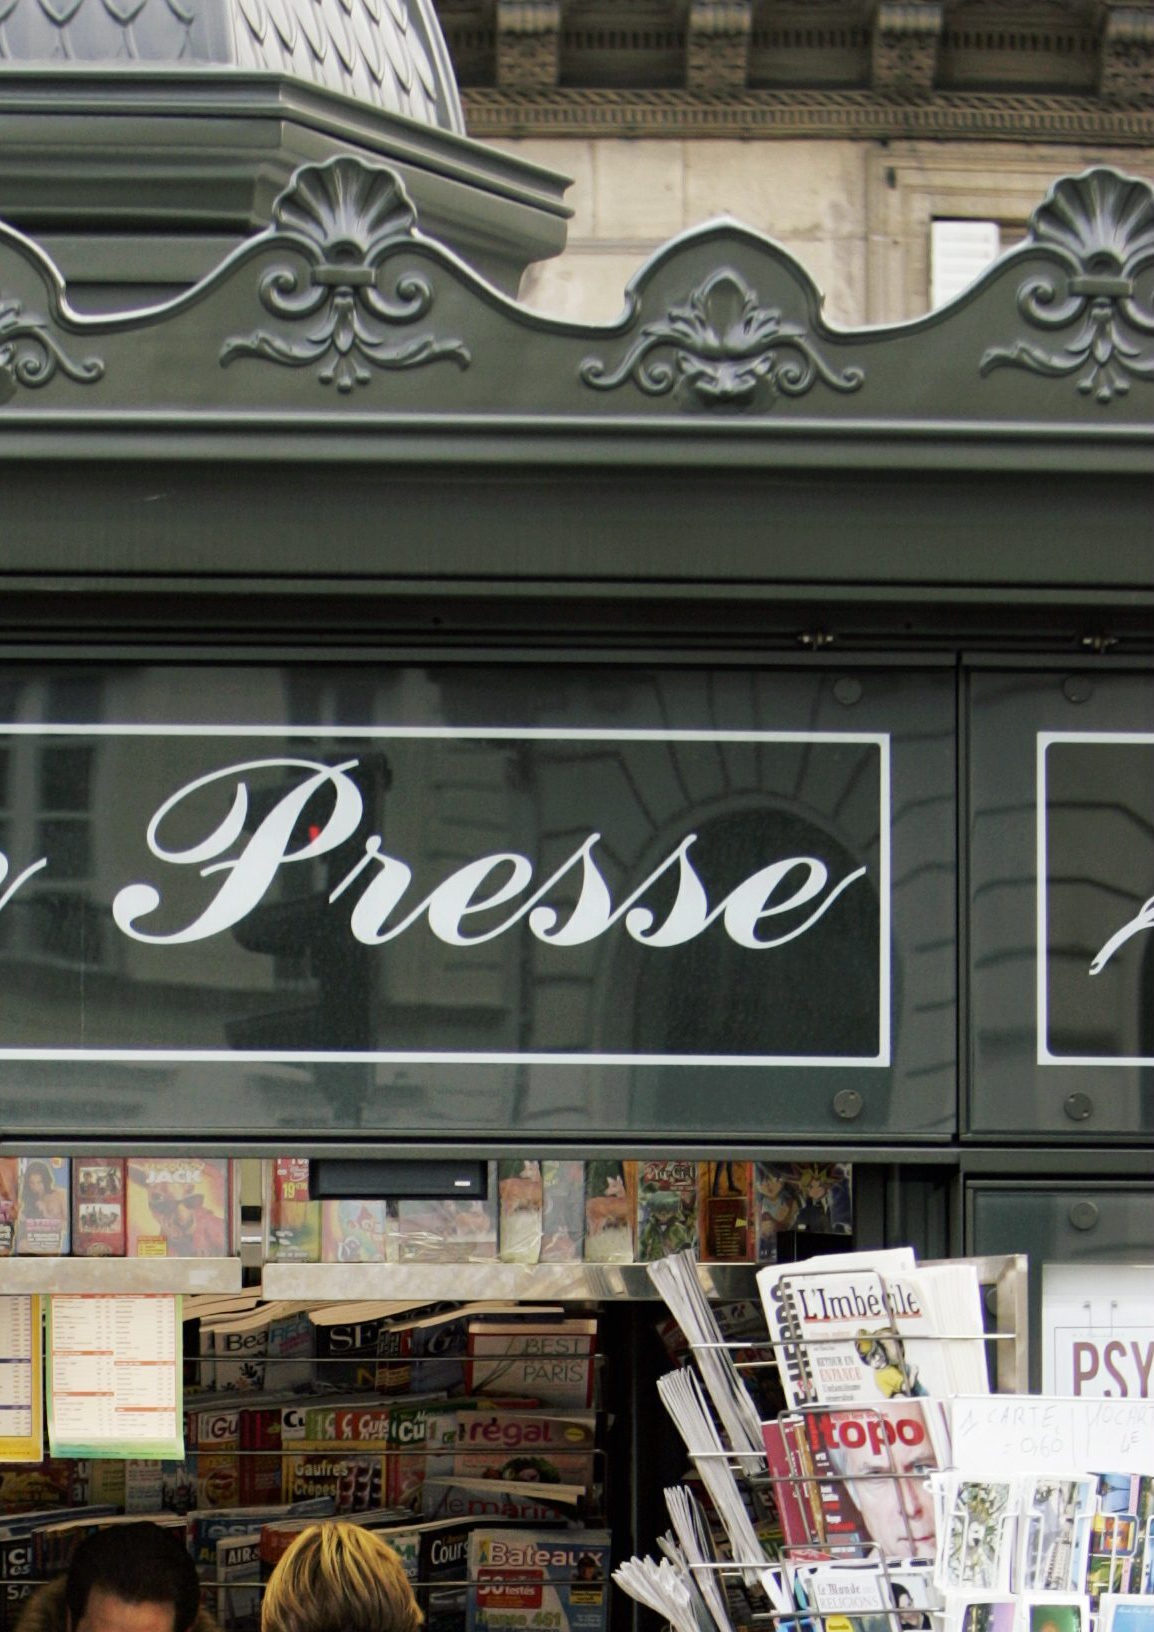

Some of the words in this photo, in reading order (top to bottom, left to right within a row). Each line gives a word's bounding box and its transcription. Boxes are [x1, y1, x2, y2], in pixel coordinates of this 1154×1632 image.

[112, 758, 866, 950] Presse
[146, 1170, 203, 1184] JACK
[525, 1338, 583, 1354] BEST
[524, 1365, 584, 1382] PARIS
[987, 1404, 1057, 1428] CARTE
[469, 1417, 553, 1447] régal
[294, 1460, 348, 1478] Gaufres
[294, 1478, 338, 1496] Crêpes
[488, 1541, 603, 1567] Bateaux
[828, 1582, 862, 1596] Monde
